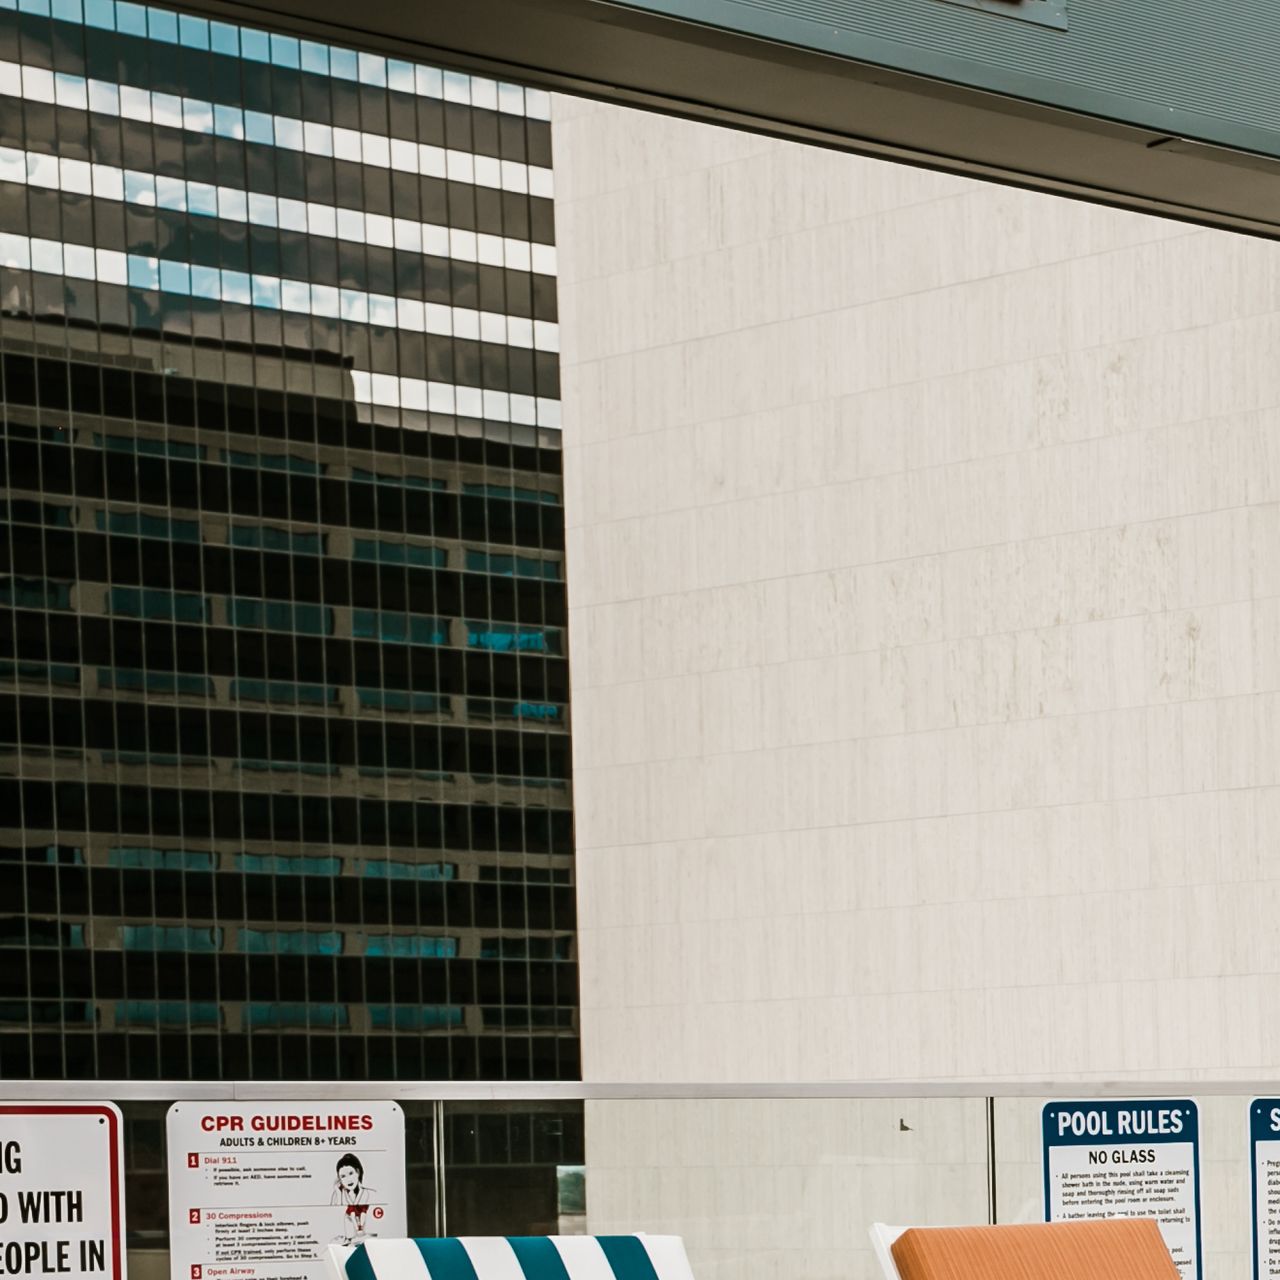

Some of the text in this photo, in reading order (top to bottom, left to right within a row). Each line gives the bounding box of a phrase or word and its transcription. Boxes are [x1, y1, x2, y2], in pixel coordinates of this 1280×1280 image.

[201, 1115, 373, 1132] CPR GUIDELINES
[1058, 1109, 1183, 1137] POOL RULES
[219, 1136, 356, 1147] ADULTS & CHILDREN 8+ YEARS
[0, 1141, 21, 1173] G
[204, 1157, 219, 1165] Dial
[221, 1156, 237, 1164] 911
[1088, 1149, 1156, 1165] NO GLASS
[18, 1191, 83, 1223] WITH
[206, 1212, 216, 1220] 30
[218, 1212, 273, 1221] Compressions
[81, 1239, 105, 1272] IN
[193, 1267, 255, 1277] 3 Open Airway
